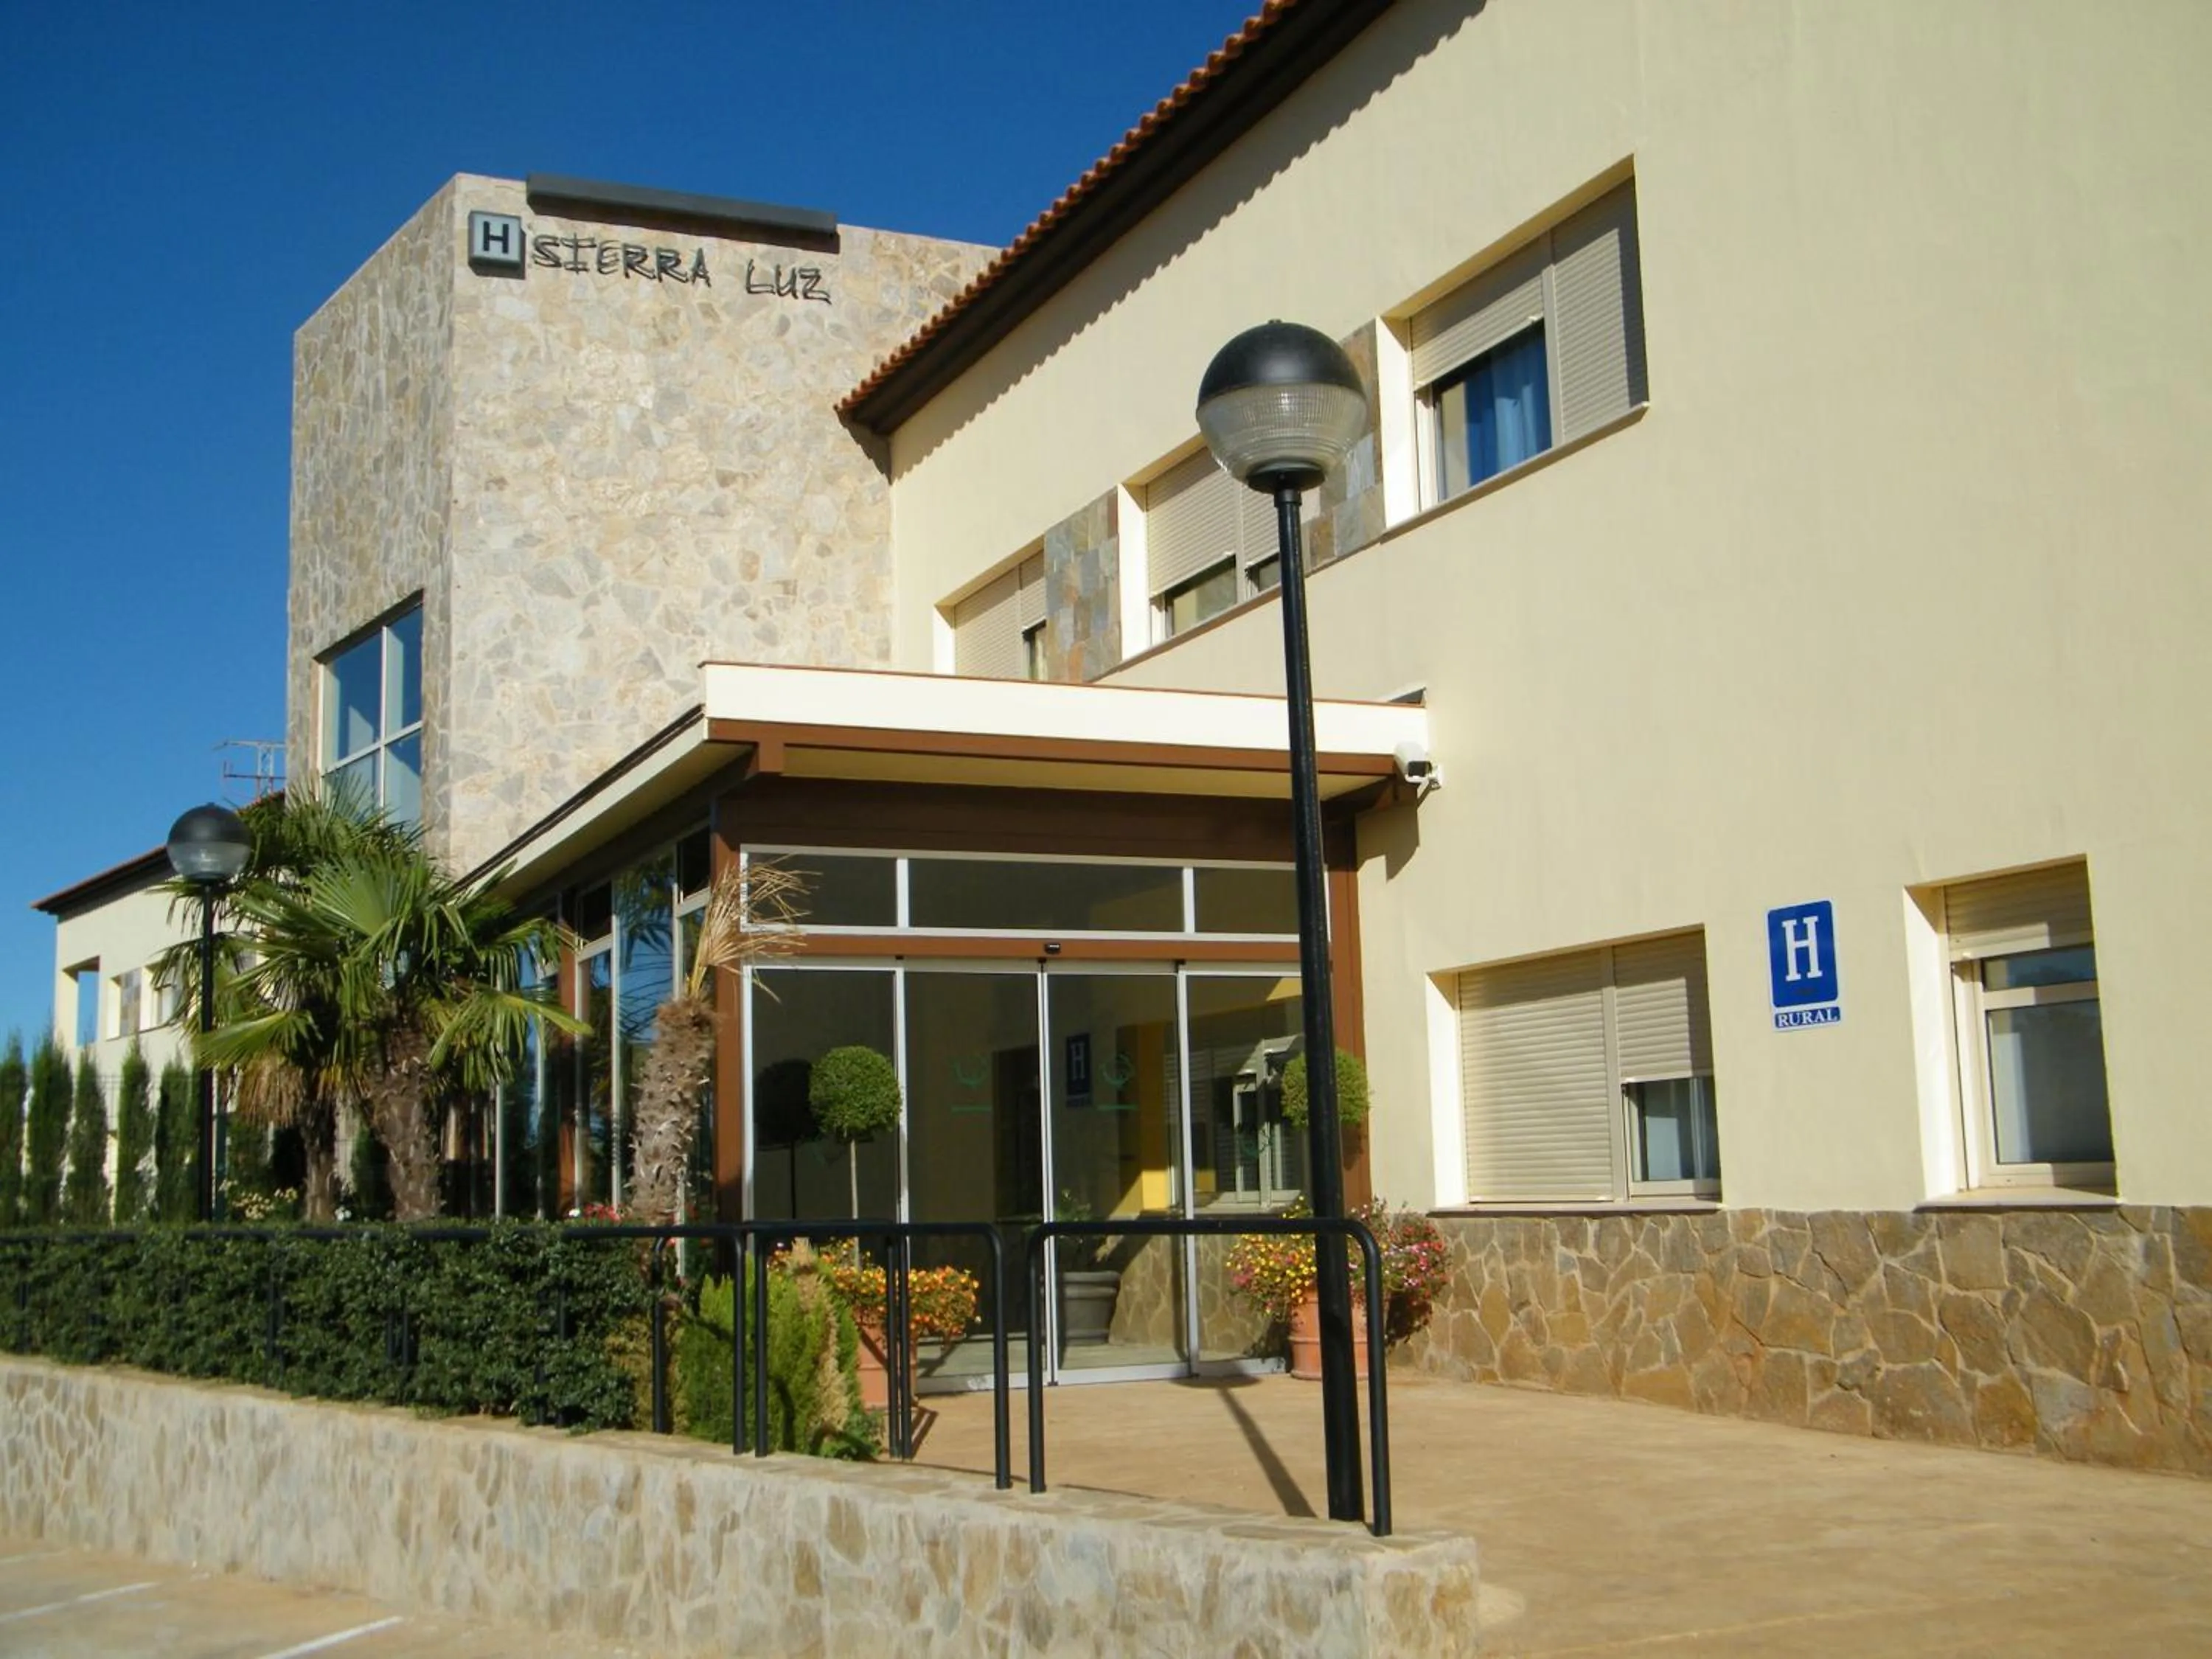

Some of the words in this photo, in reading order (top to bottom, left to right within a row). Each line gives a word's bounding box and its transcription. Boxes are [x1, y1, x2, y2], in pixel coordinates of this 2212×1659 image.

[483, 221, 509, 254] H
[532, 233, 711, 288] SIERRA
[745, 259, 832, 305] LUZ
[1781, 916, 1823, 981] H
[1777, 1007, 1837, 1027] RURAL
